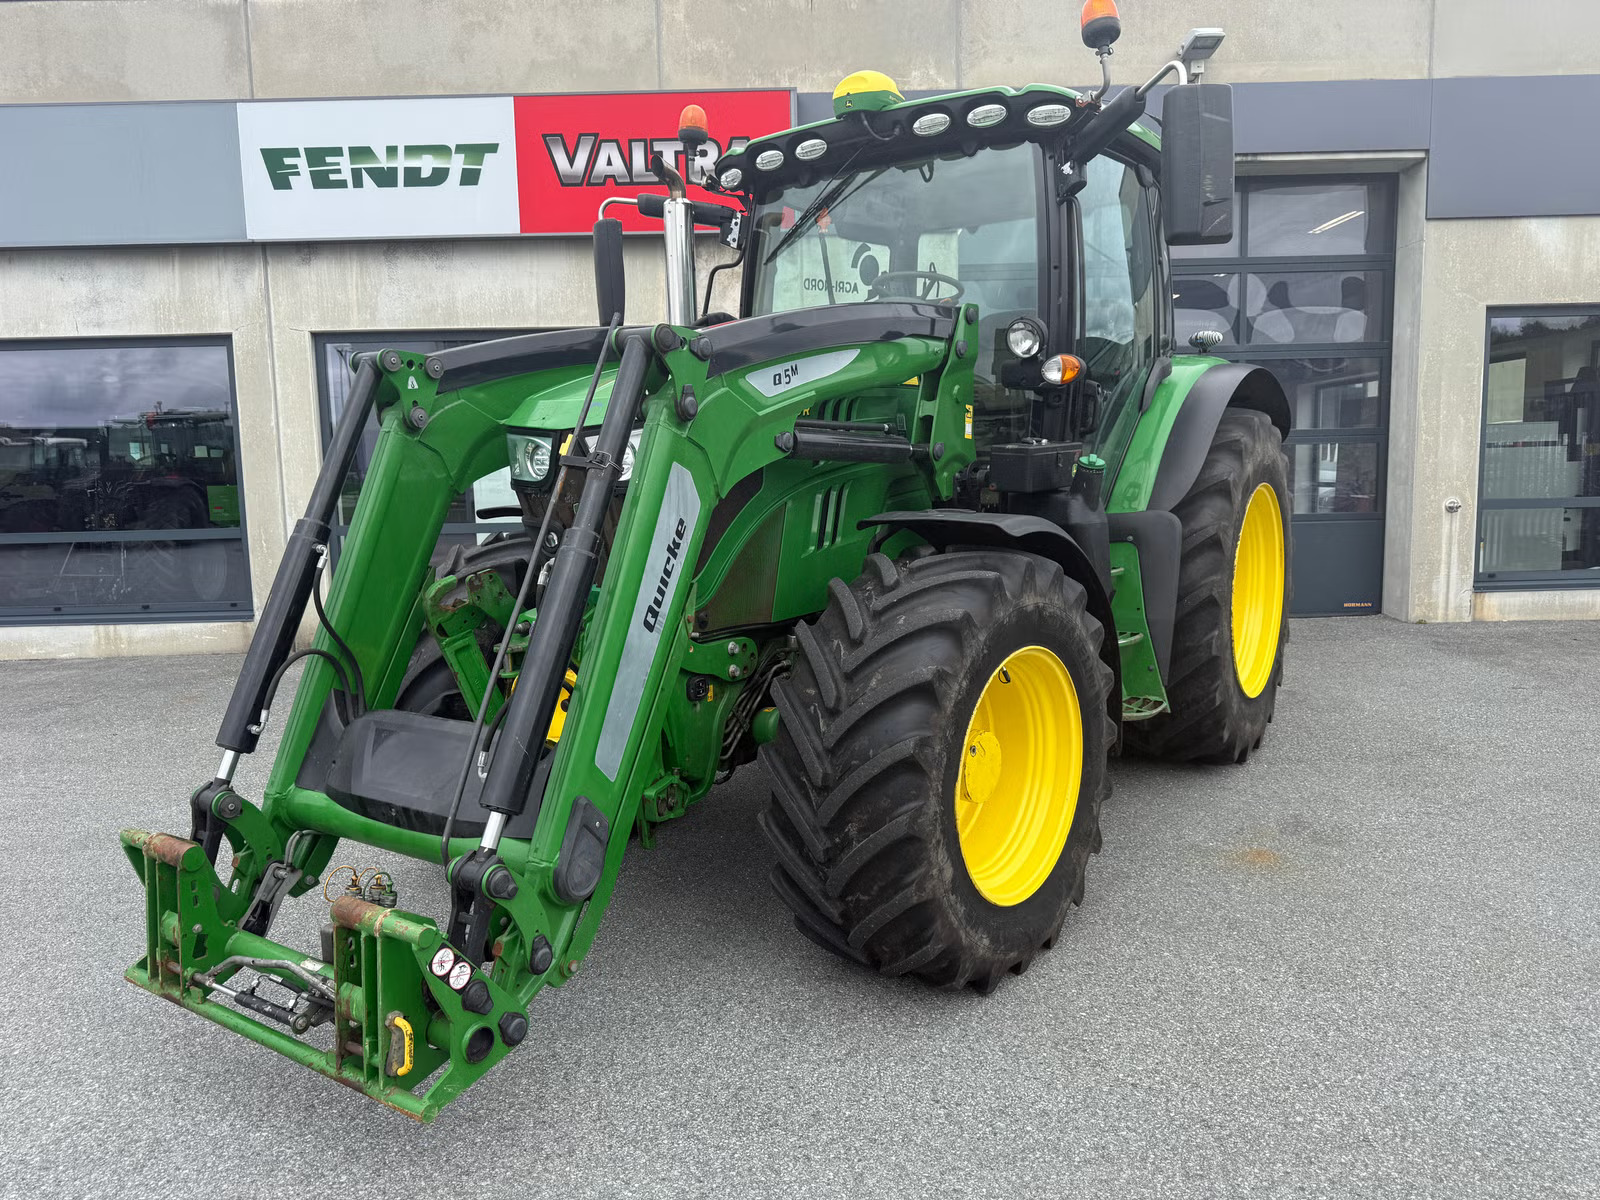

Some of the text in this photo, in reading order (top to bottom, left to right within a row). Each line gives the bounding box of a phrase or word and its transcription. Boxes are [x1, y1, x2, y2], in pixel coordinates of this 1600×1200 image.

[260, 143, 500, 190] FENDT
[541, 132, 752, 187] VALTR
[643, 517, 687, 634] Quicke
